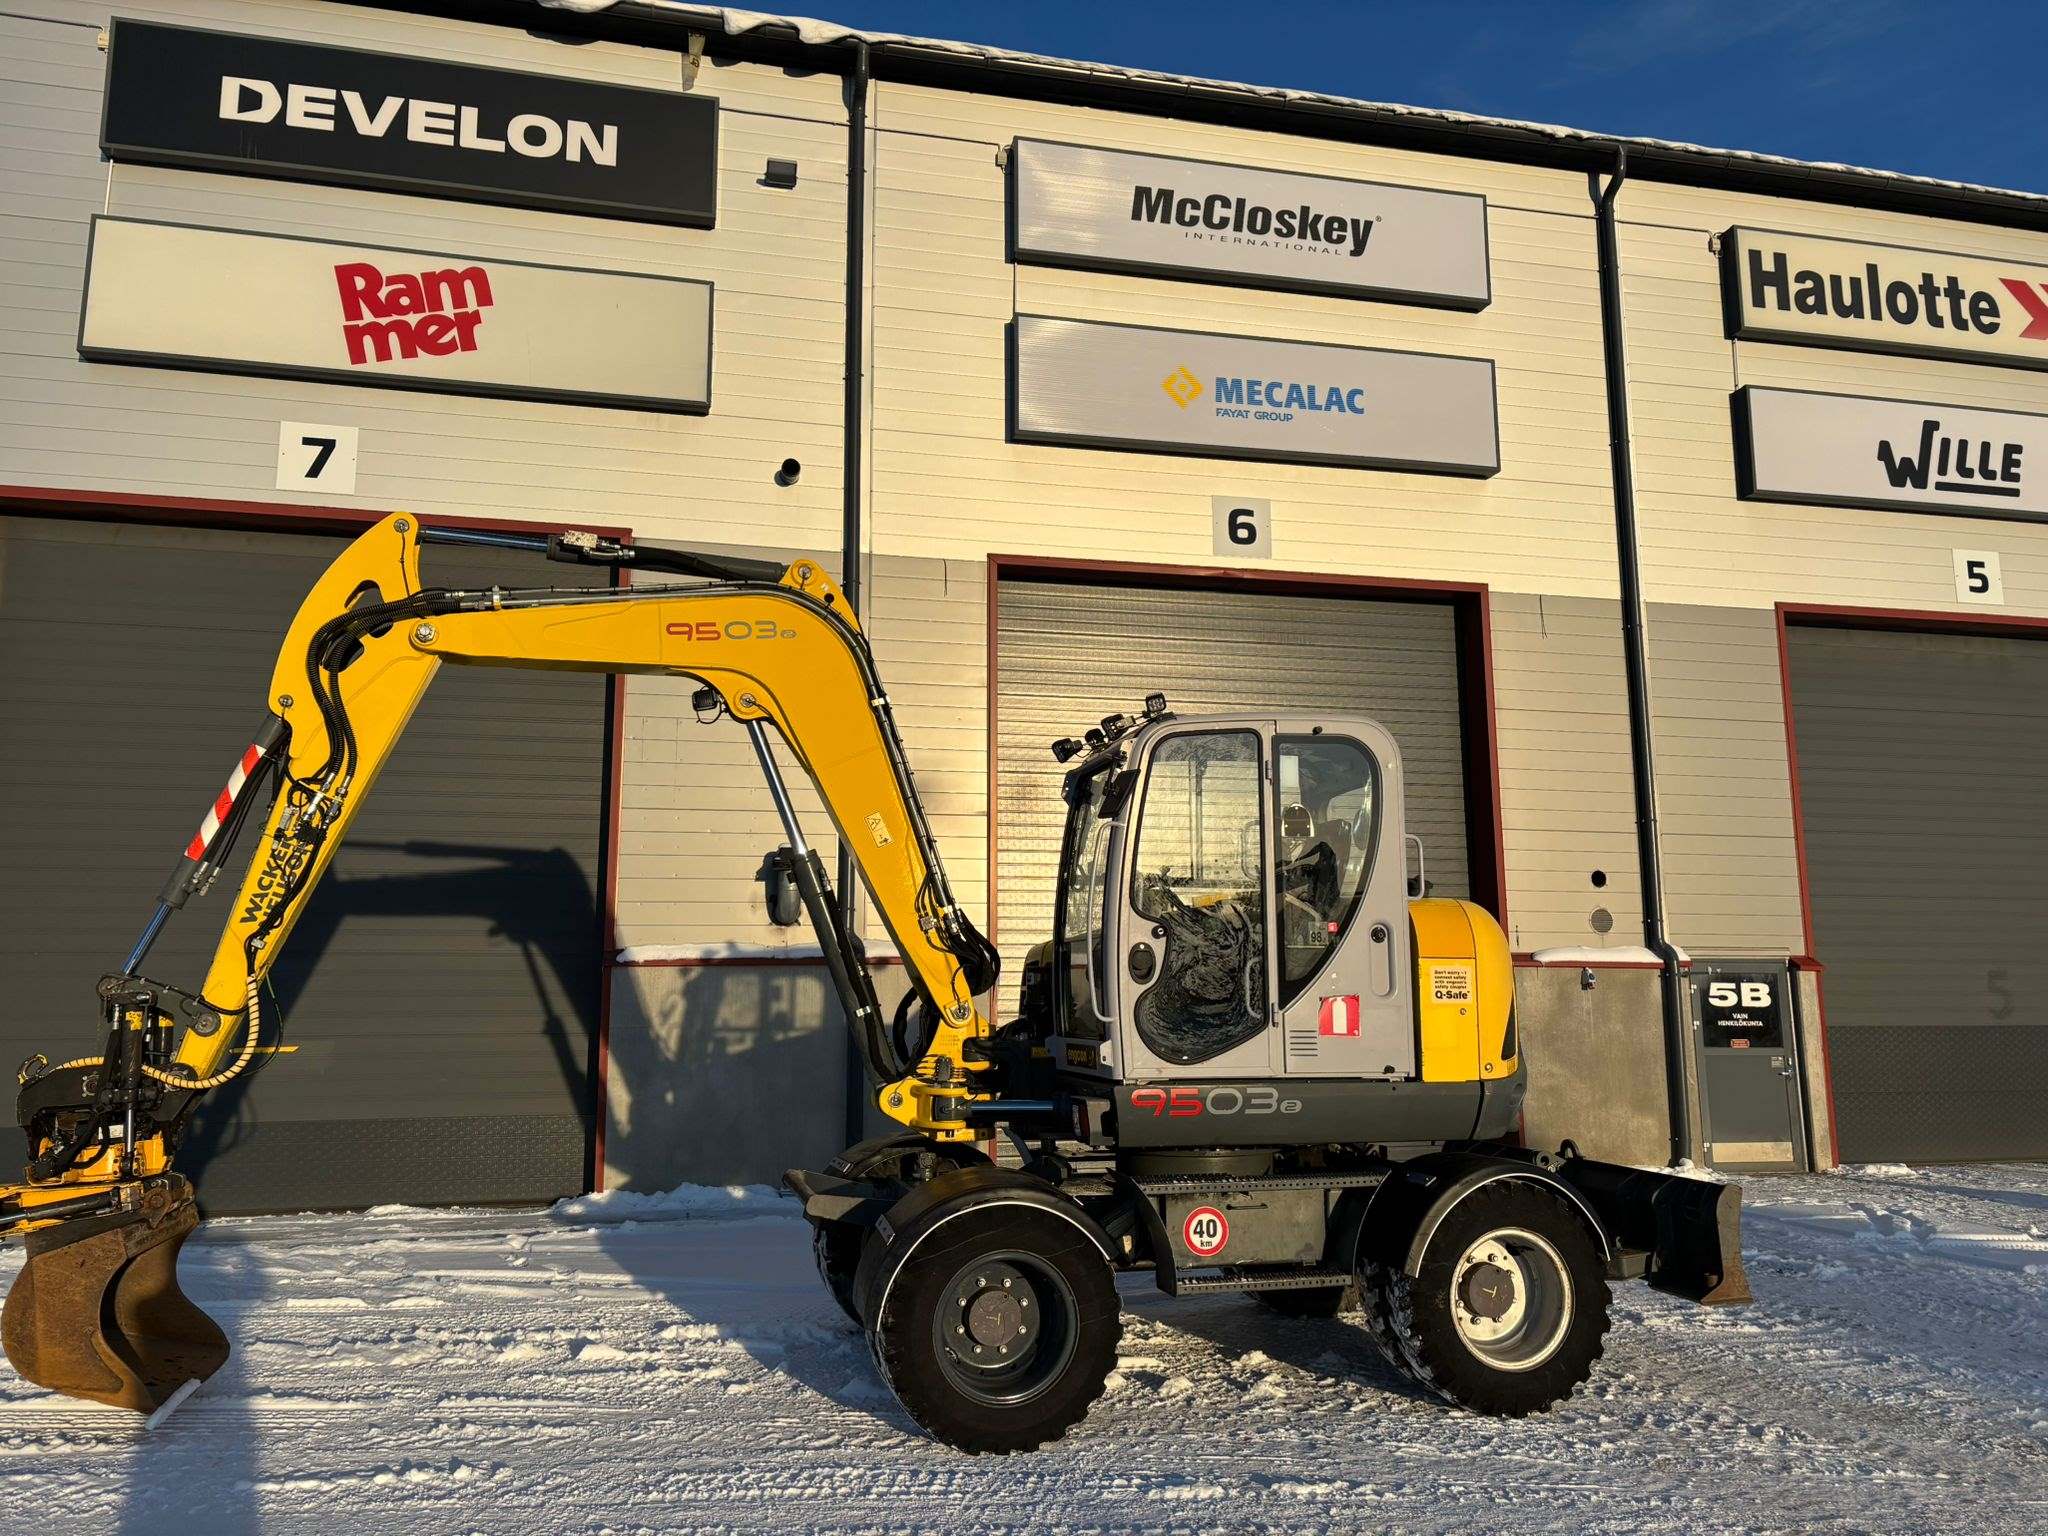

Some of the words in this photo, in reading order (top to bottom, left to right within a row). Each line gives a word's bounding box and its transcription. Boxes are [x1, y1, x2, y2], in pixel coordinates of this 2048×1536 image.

[219, 76, 618, 167] DEVELON
[1131, 185, 1373, 257] McCloskey
[1185, 231, 1342, 255] INTERNATIONAL
[1748, 249, 2001, 335] Haulotte
[1215, 377, 1364, 415] MECALAC
[1216, 408, 1250, 419] FAYAT
[1254, 411, 1293, 422] GROUP
[301, 437, 337, 479] 7
[1228, 509, 1257, 546] 6
[1967, 561, 1990, 594] 5
[1310, 931, 1323, 943] 98
[1708, 982, 1772, 1008] 5B
[1732, 1012, 1749, 1020] VAIN
[1193, 1218, 1218, 1239] 40
[1199, 1239, 1214, 1248] km
